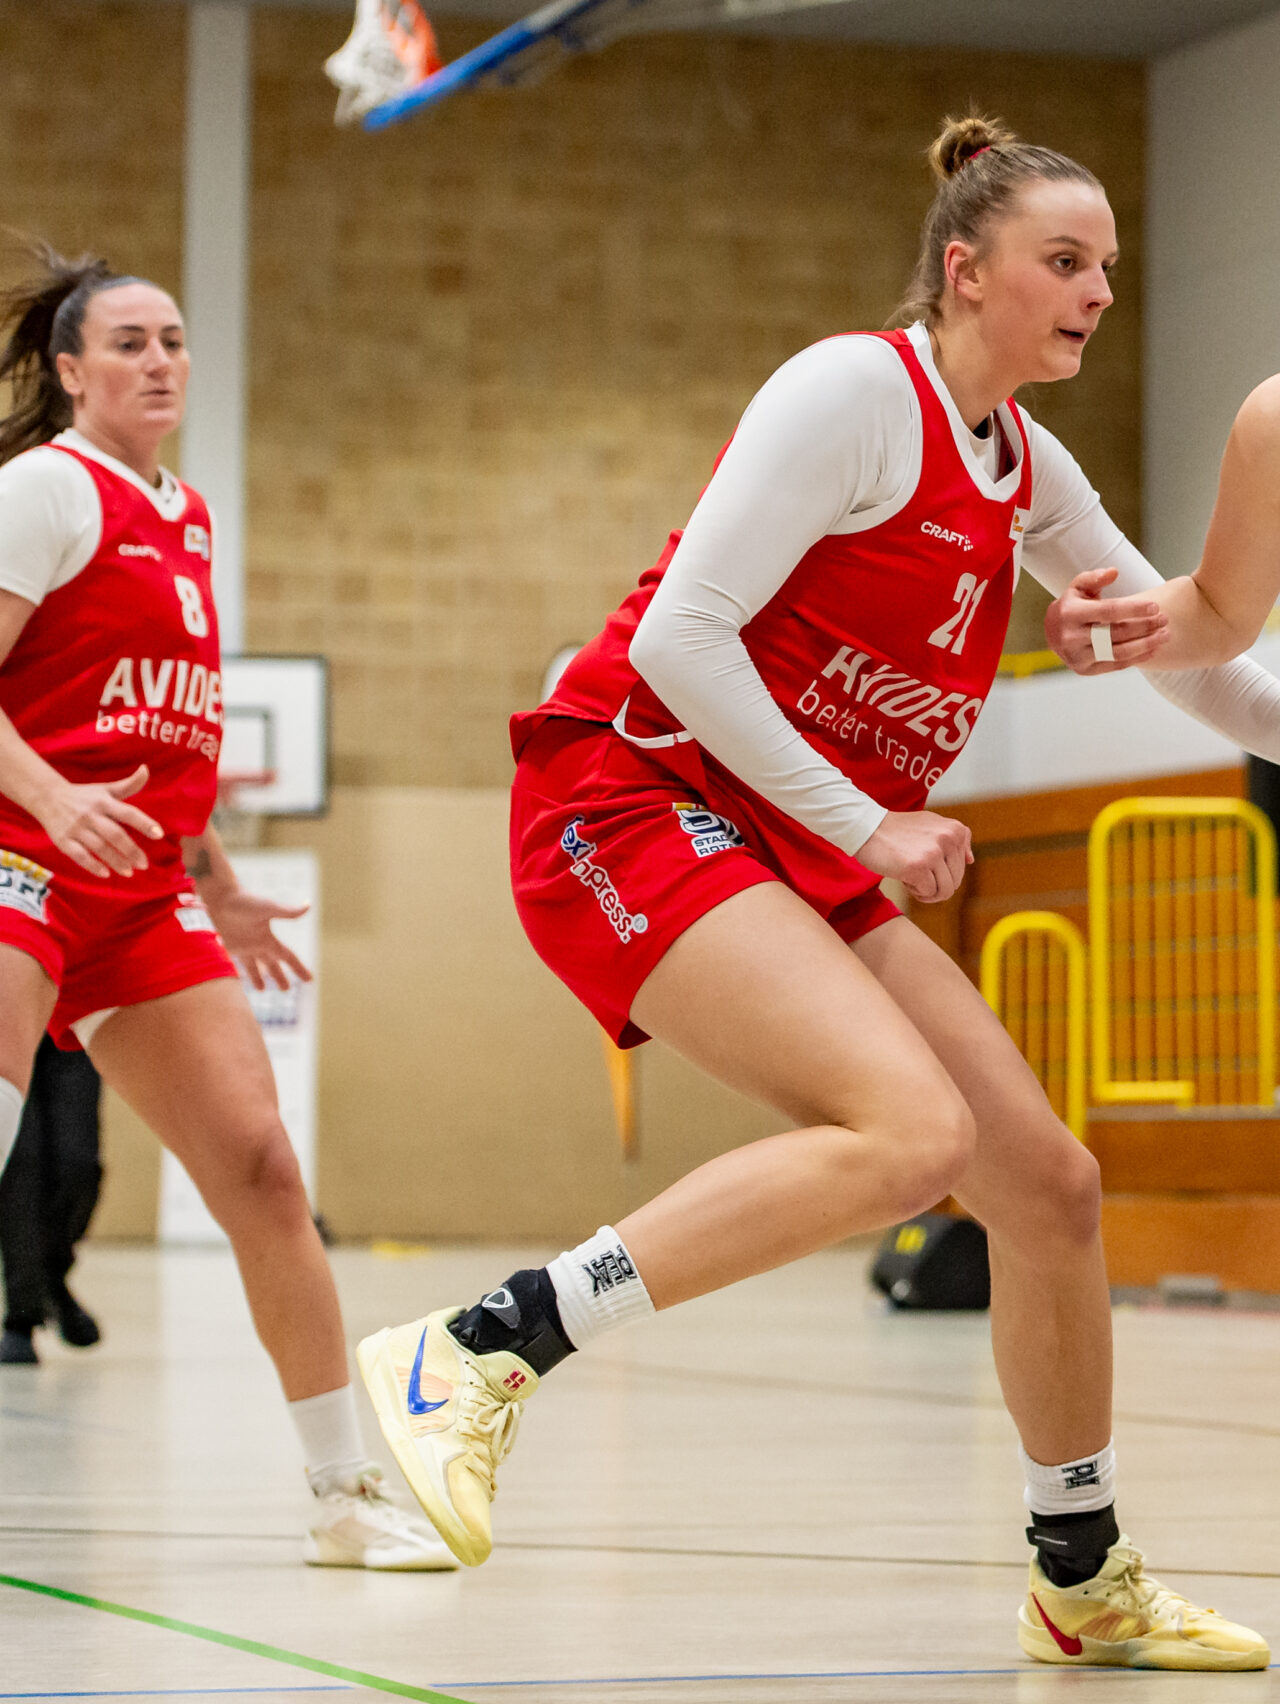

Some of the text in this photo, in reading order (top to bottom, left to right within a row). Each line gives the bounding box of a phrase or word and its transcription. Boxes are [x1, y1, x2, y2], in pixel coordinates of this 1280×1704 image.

[920, 521, 966, 547] CRAFT
[174, 575, 208, 638] 8
[927, 572, 989, 655] 21
[99, 658, 224, 730] AVIDE
[95, 710, 188, 745] better
[874, 725, 943, 789] trade
